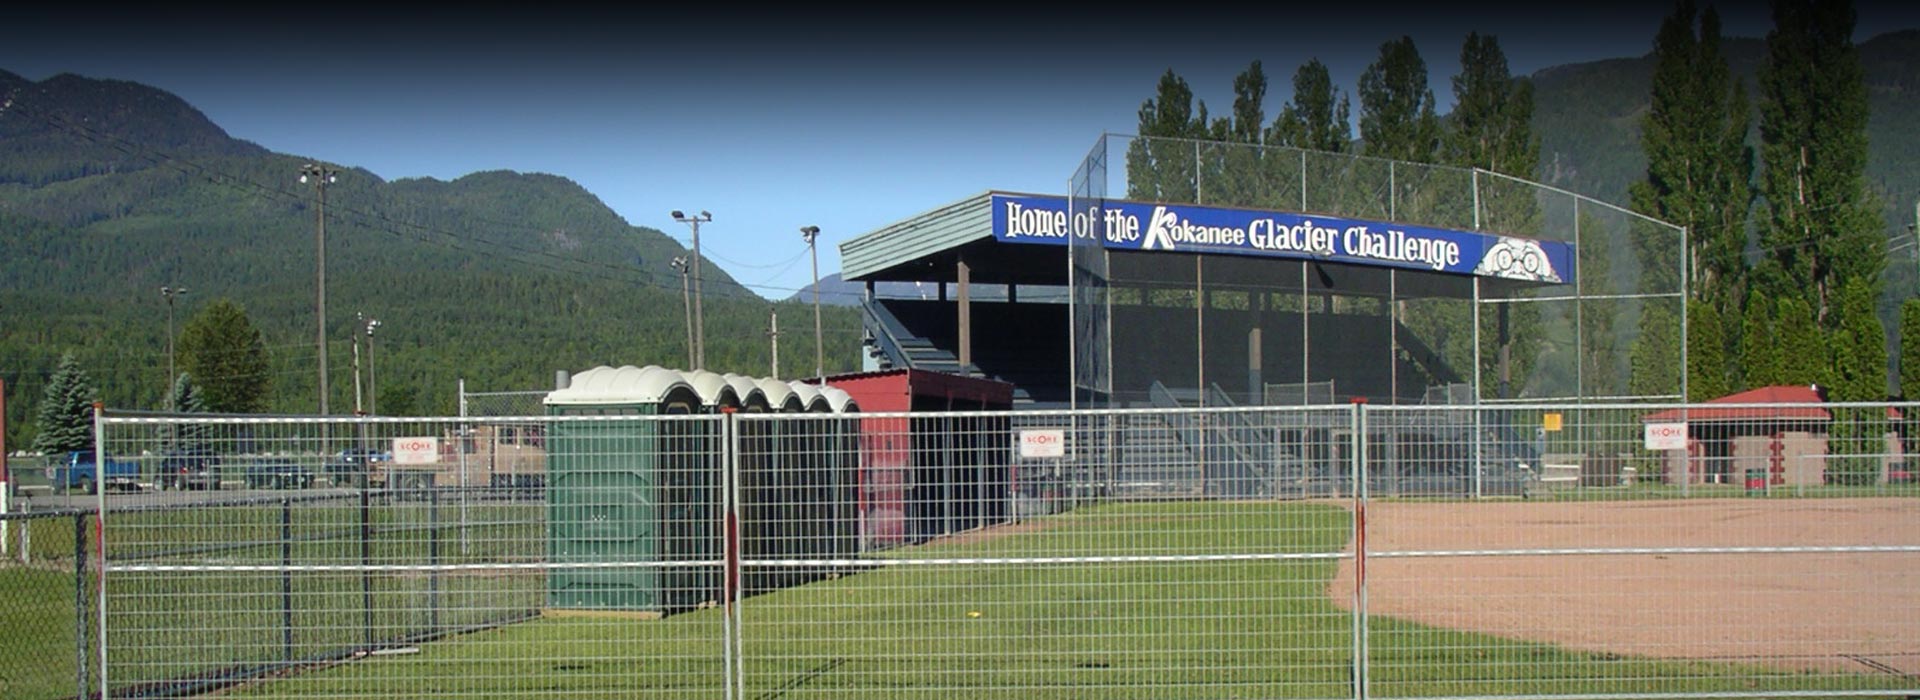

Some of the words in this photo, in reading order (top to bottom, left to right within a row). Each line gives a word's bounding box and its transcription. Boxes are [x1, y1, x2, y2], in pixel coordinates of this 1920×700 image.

[1005, 202, 1068, 238] Home
[1073, 207, 1098, 240] of
[1104, 209, 1140, 243] the
[1142, 206, 1245, 249] Kokanee
[1248, 219, 1338, 254] Glacier
[1343, 224, 1460, 270] Challenge
